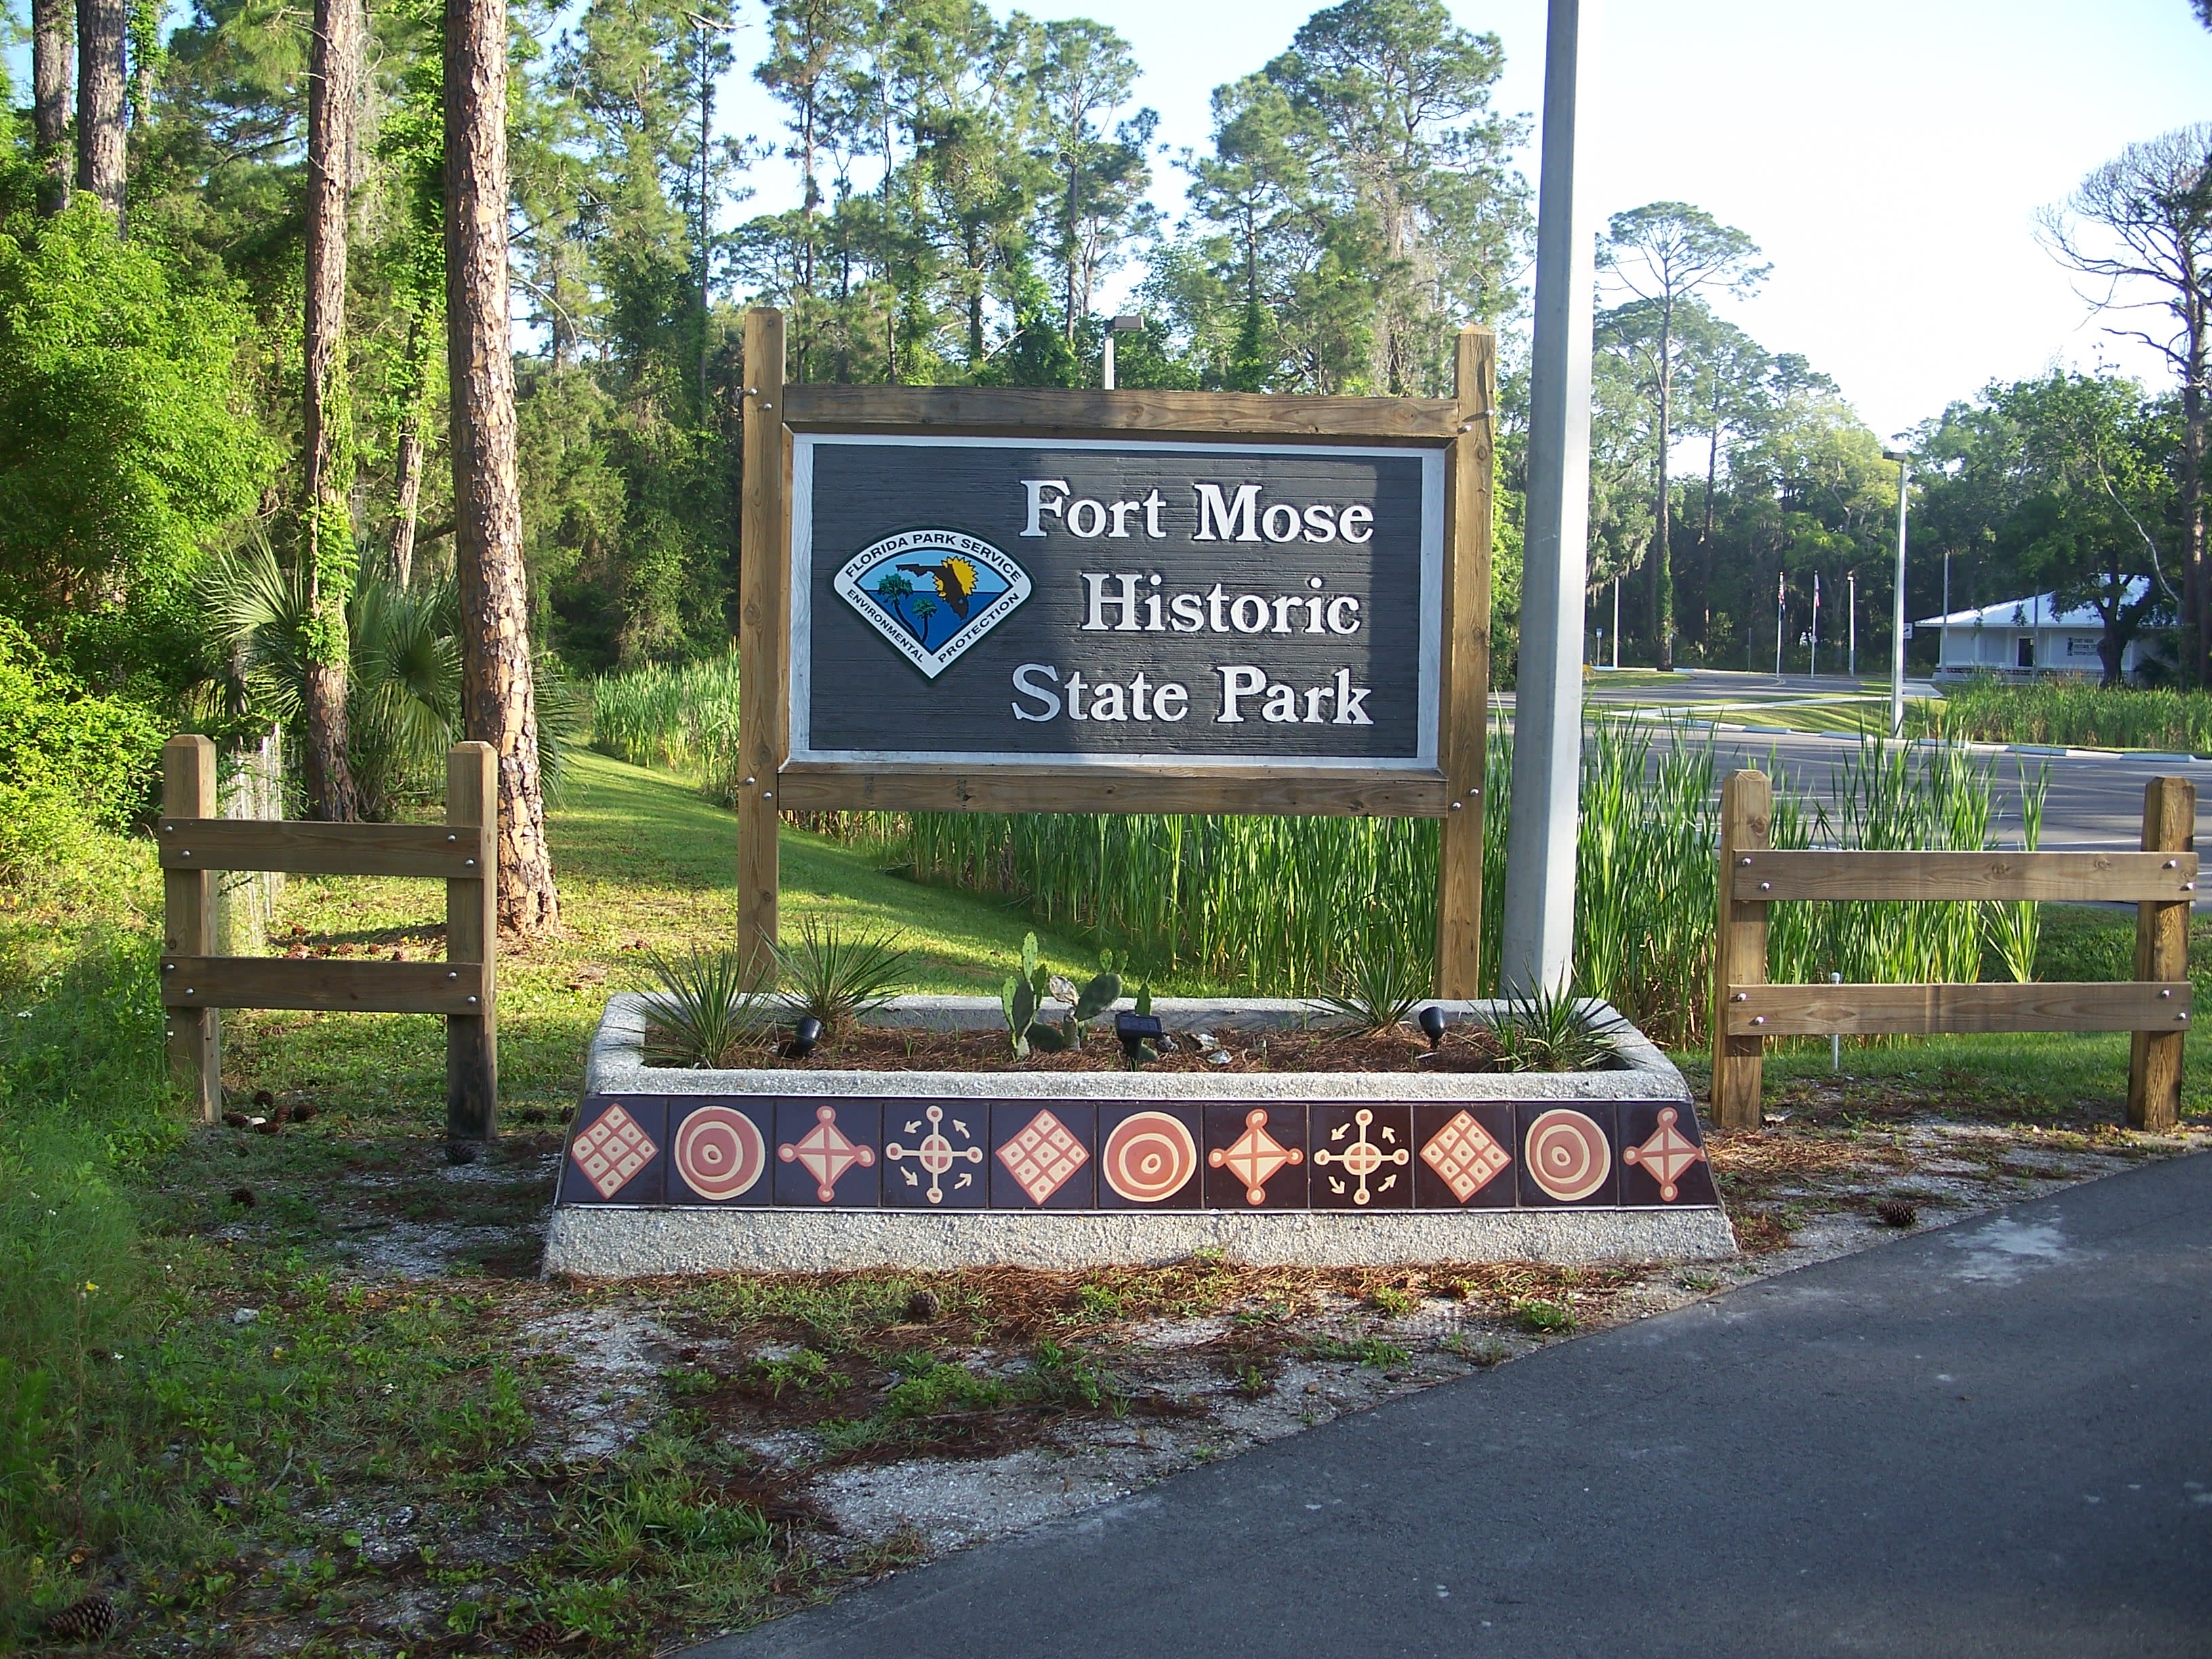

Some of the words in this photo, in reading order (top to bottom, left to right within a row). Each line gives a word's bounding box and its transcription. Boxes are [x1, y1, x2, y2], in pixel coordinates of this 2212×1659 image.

[1019, 480, 1166, 538] Fort
[1193, 483, 1374, 543] Mose
[845, 537, 909, 578] FLORIDA
[912, 533, 957, 546] PARK
[960, 538, 1022, 582] SERVICE
[847, 589, 924, 663] ENVIRONMENTAL
[938, 593, 1020, 663] PROTECTION
[1082, 573, 1360, 634] Historic
[1011, 663, 1189, 722] State
[1217, 665, 1374, 725] Park
